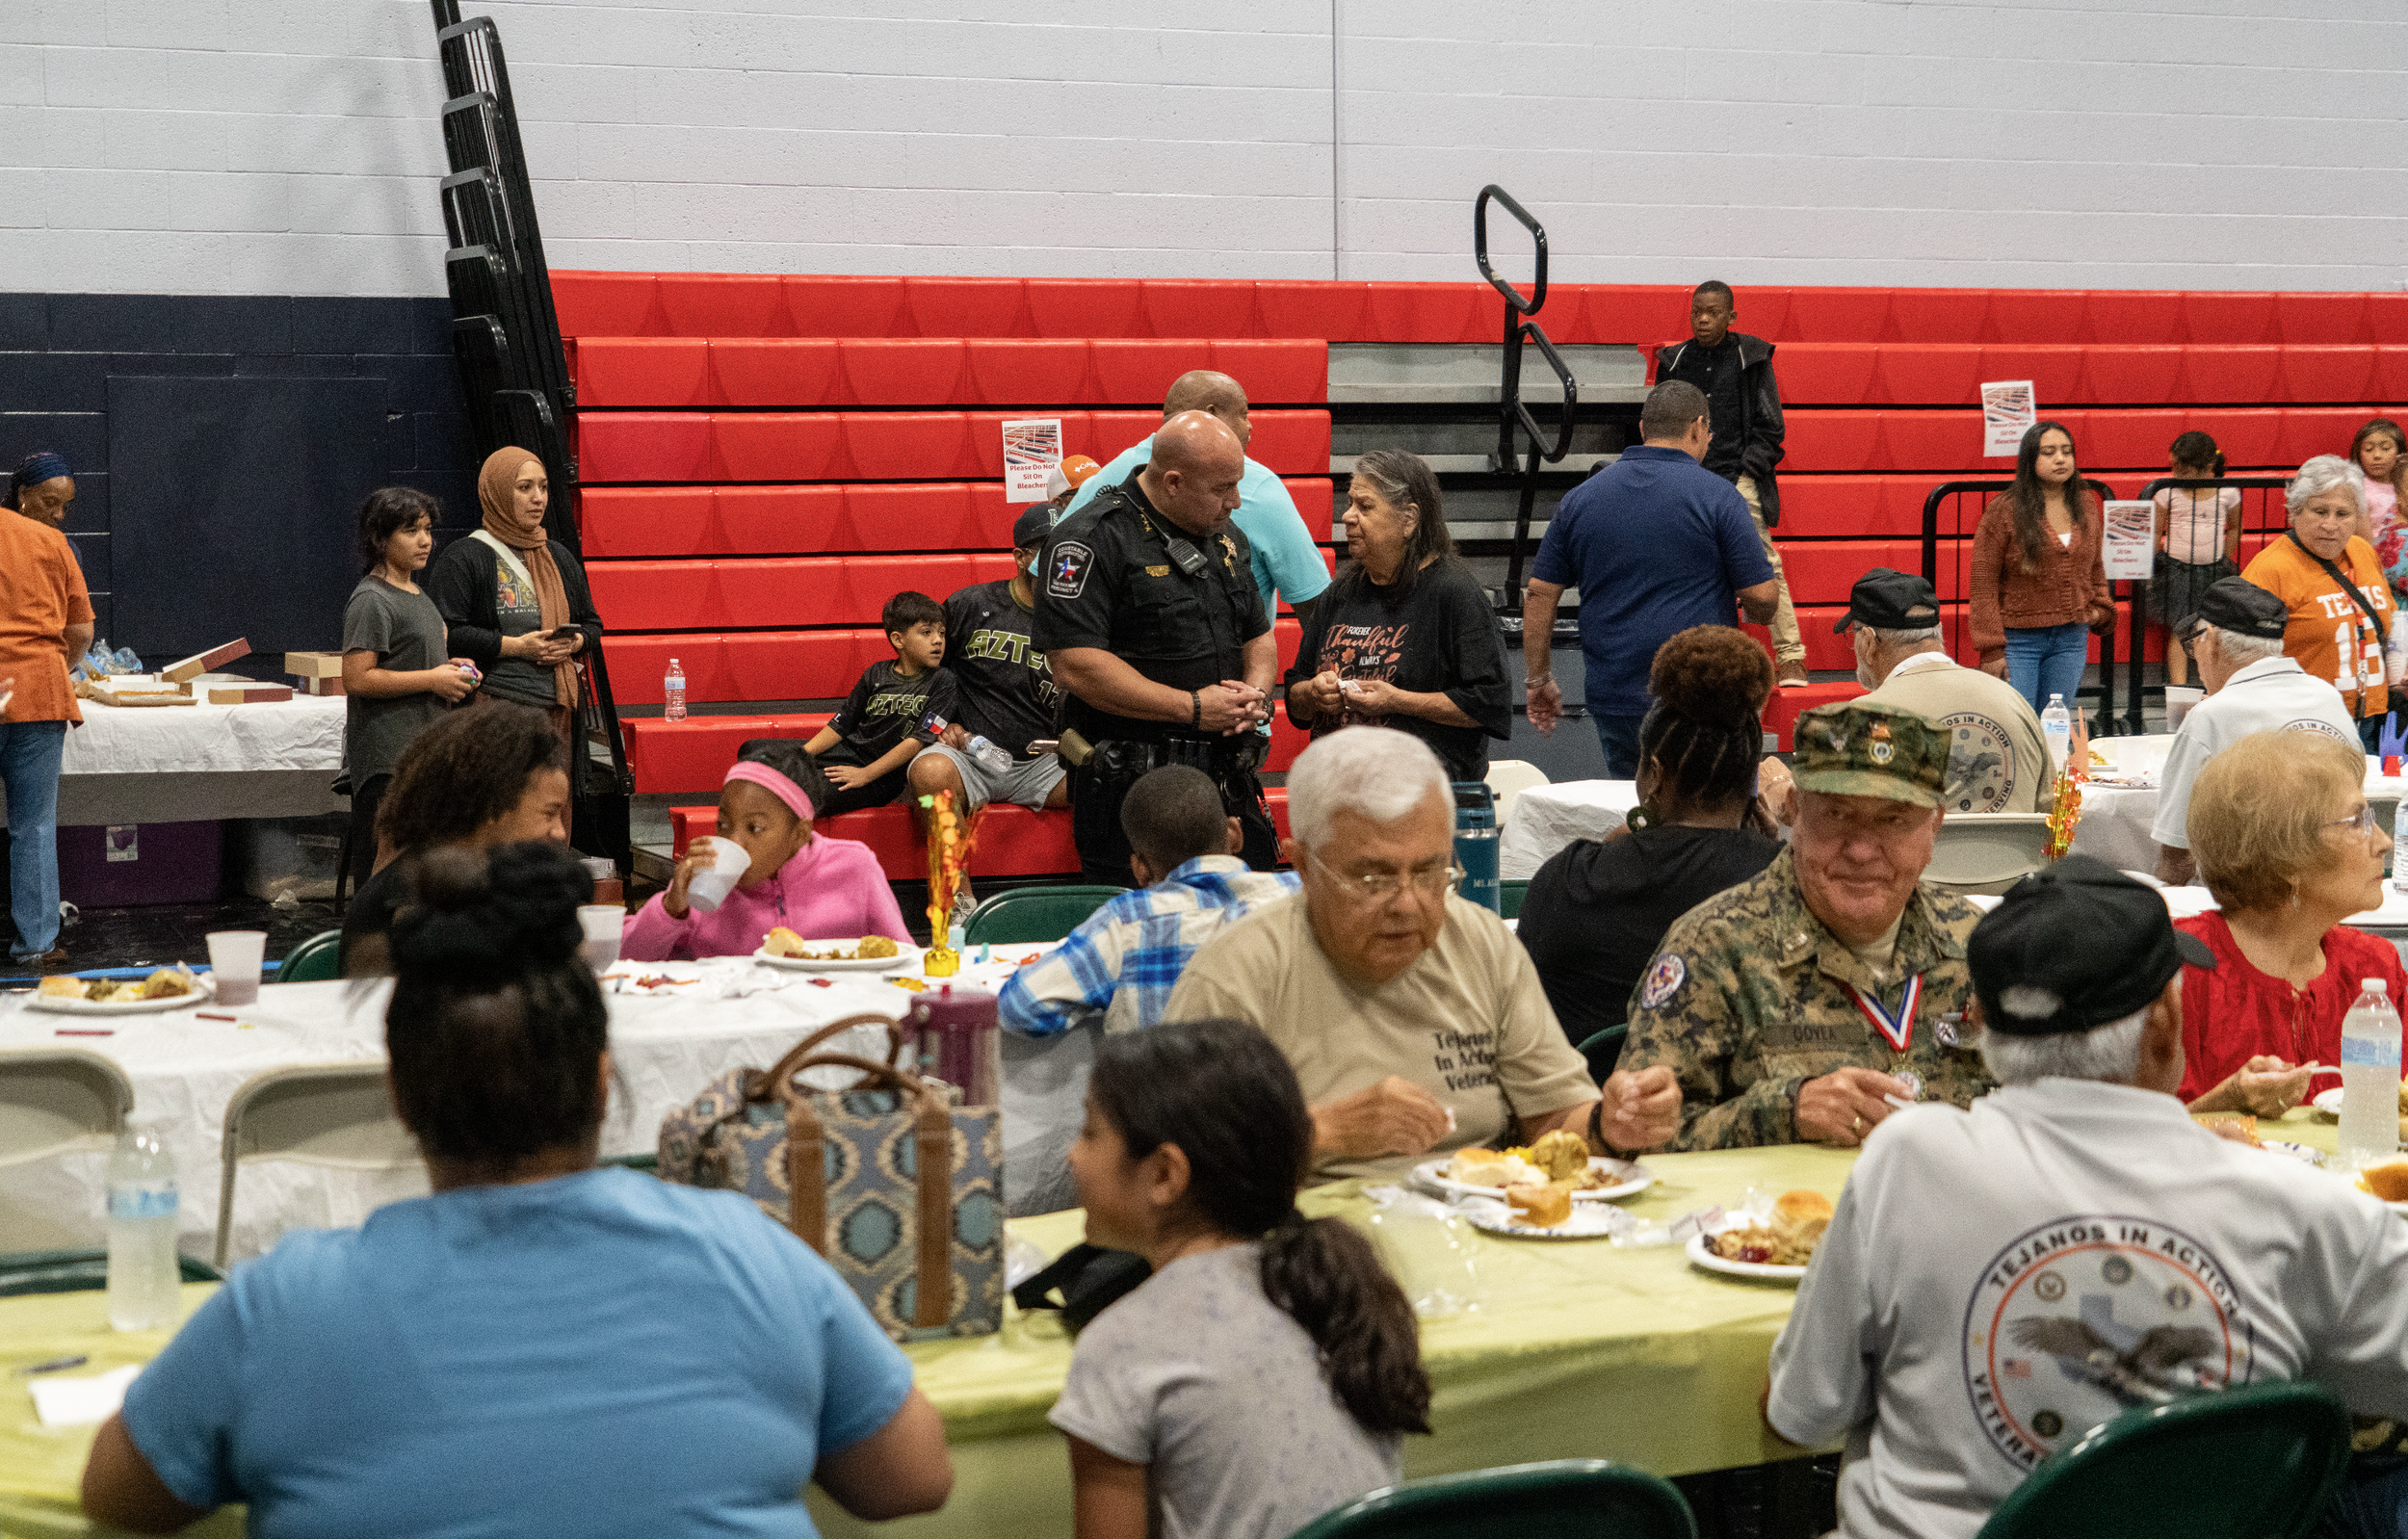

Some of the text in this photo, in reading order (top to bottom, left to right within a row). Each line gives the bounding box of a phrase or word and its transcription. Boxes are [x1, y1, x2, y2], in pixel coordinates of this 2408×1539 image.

[2316, 586, 2388, 619] TEAS
[1326, 624, 1409, 656] Thankful
[1347, 626, 1372, 636] FOREVER
[1359, 656, 1380, 666] ALWAYS
[1978, 718, 2009, 748] ACTION
[1984, 779, 2012, 814] ERVING
[1990, 1225, 2238, 1317] TEJANOS IN ACTION
